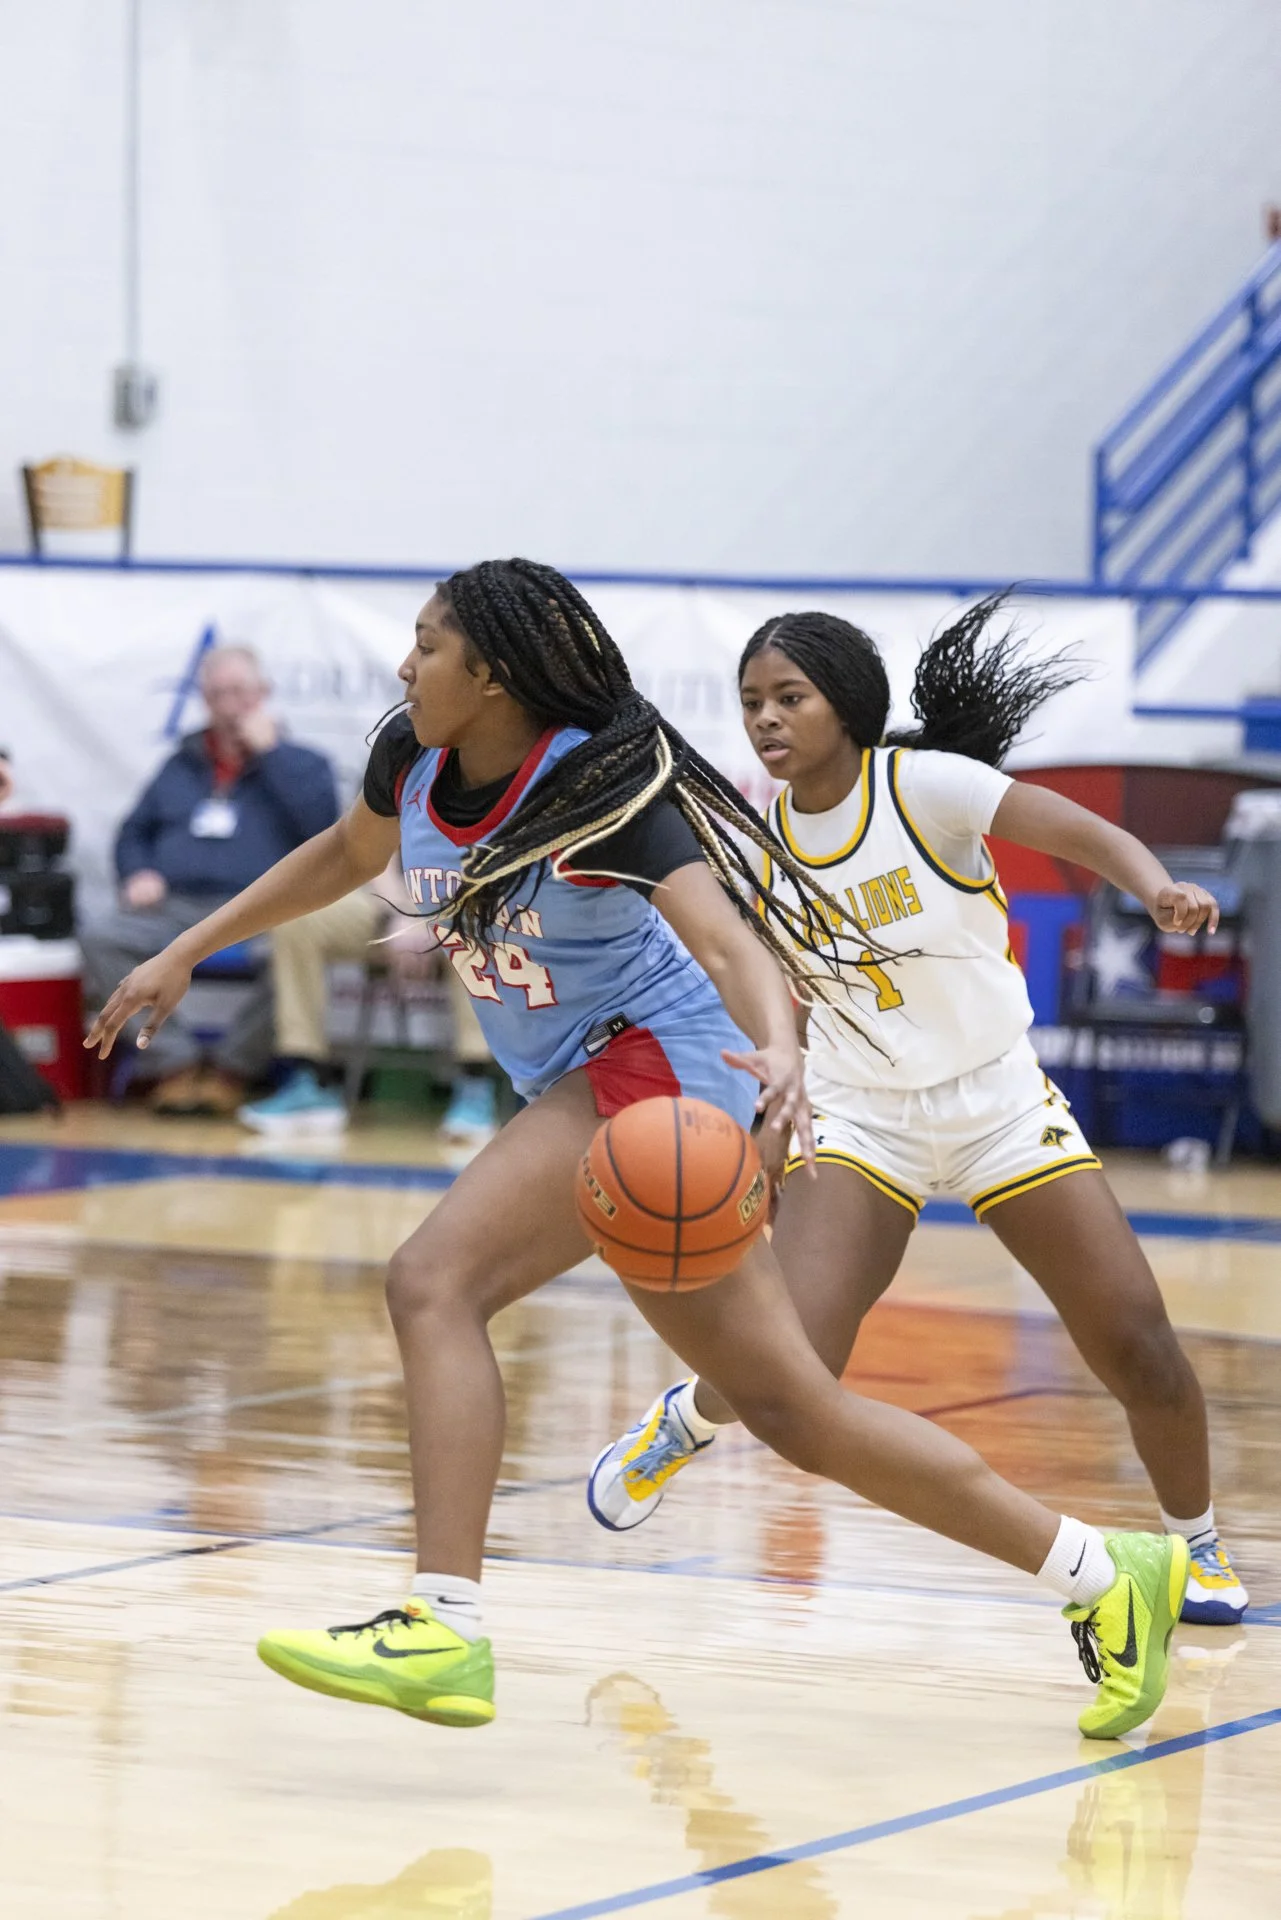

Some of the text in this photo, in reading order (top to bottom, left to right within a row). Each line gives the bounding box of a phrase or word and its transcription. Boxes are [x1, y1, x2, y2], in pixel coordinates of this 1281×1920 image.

[844, 865, 924, 932] LIONS
[433, 923, 560, 1011] 24
[855, 949, 905, 1013] 1
[612, 1021, 624, 1032] M
